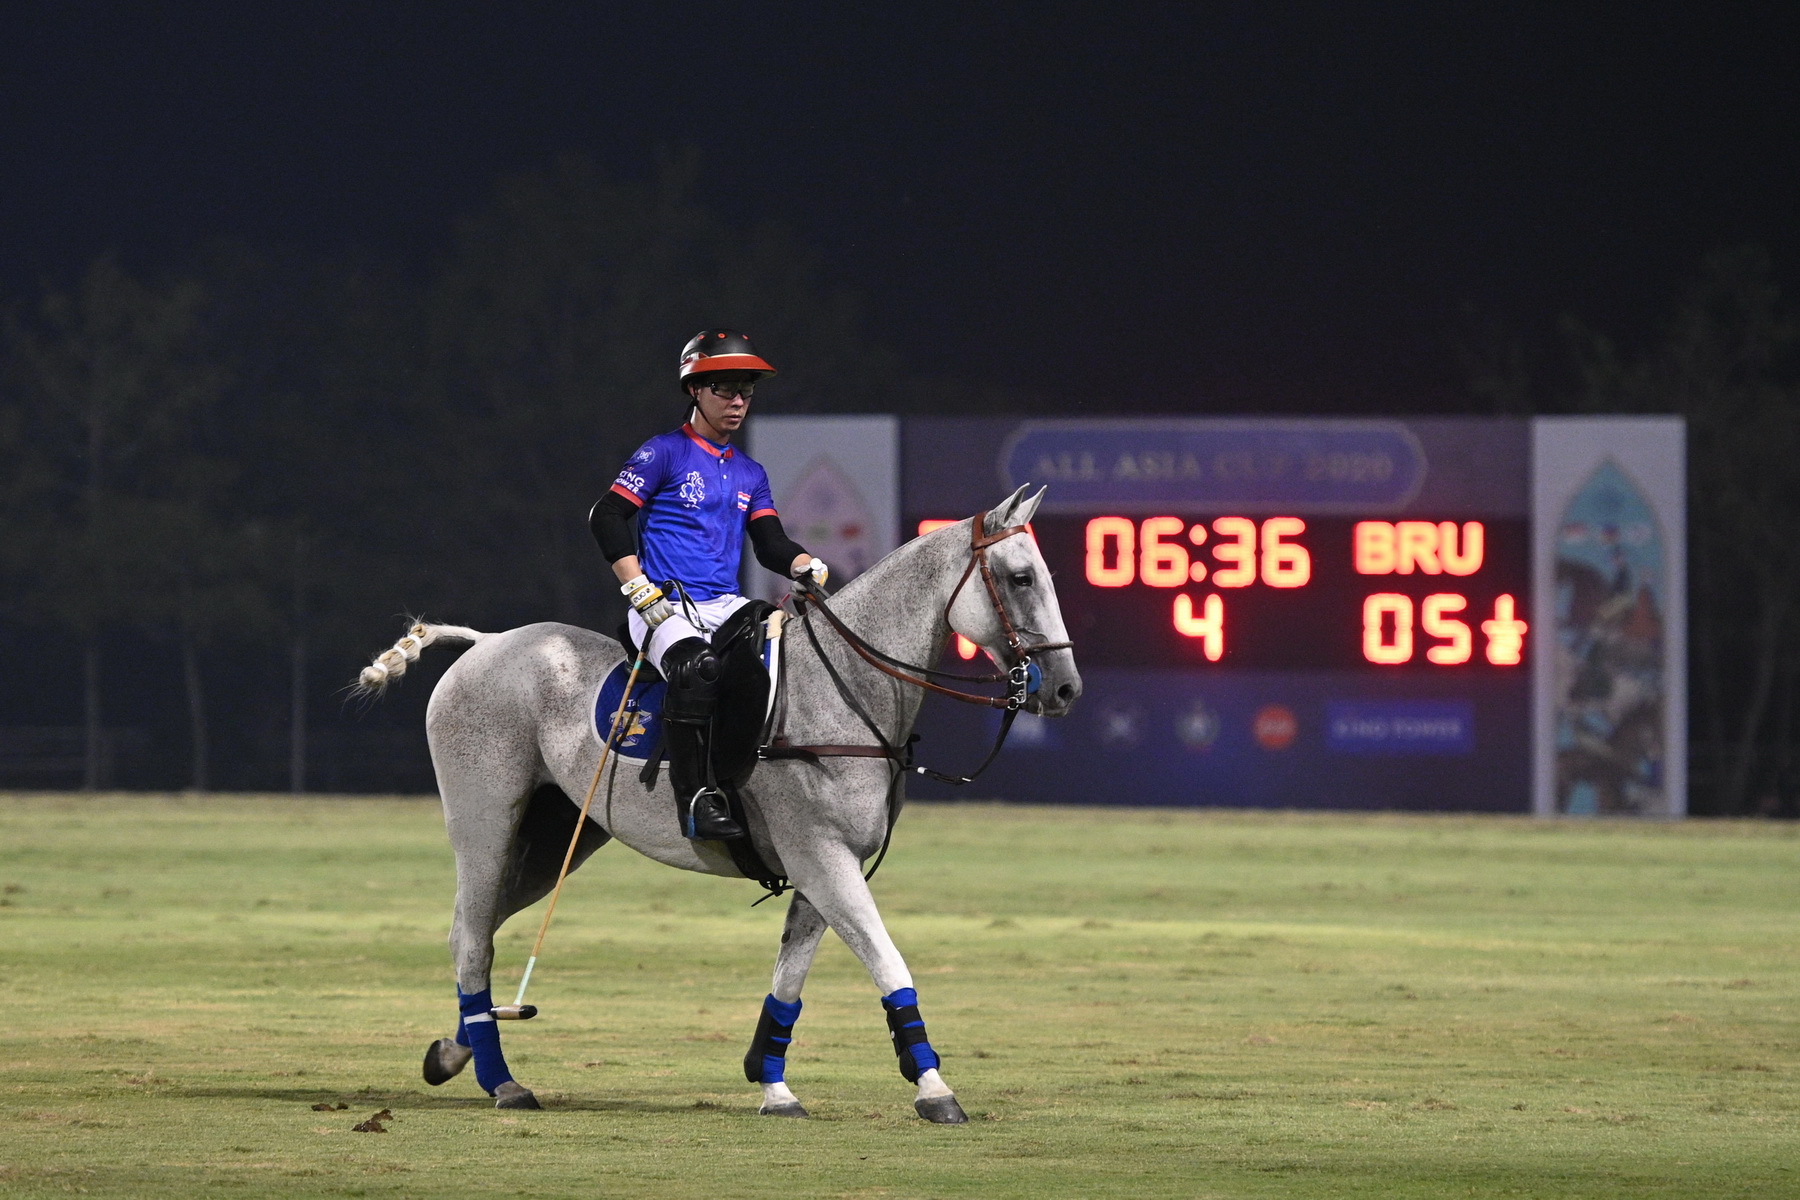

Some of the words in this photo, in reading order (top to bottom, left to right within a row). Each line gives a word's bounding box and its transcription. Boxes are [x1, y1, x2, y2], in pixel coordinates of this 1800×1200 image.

[1085, 516, 1311, 589] 06:36
[1354, 520, 1485, 577] BRU
[1173, 593, 1224, 662] 4
